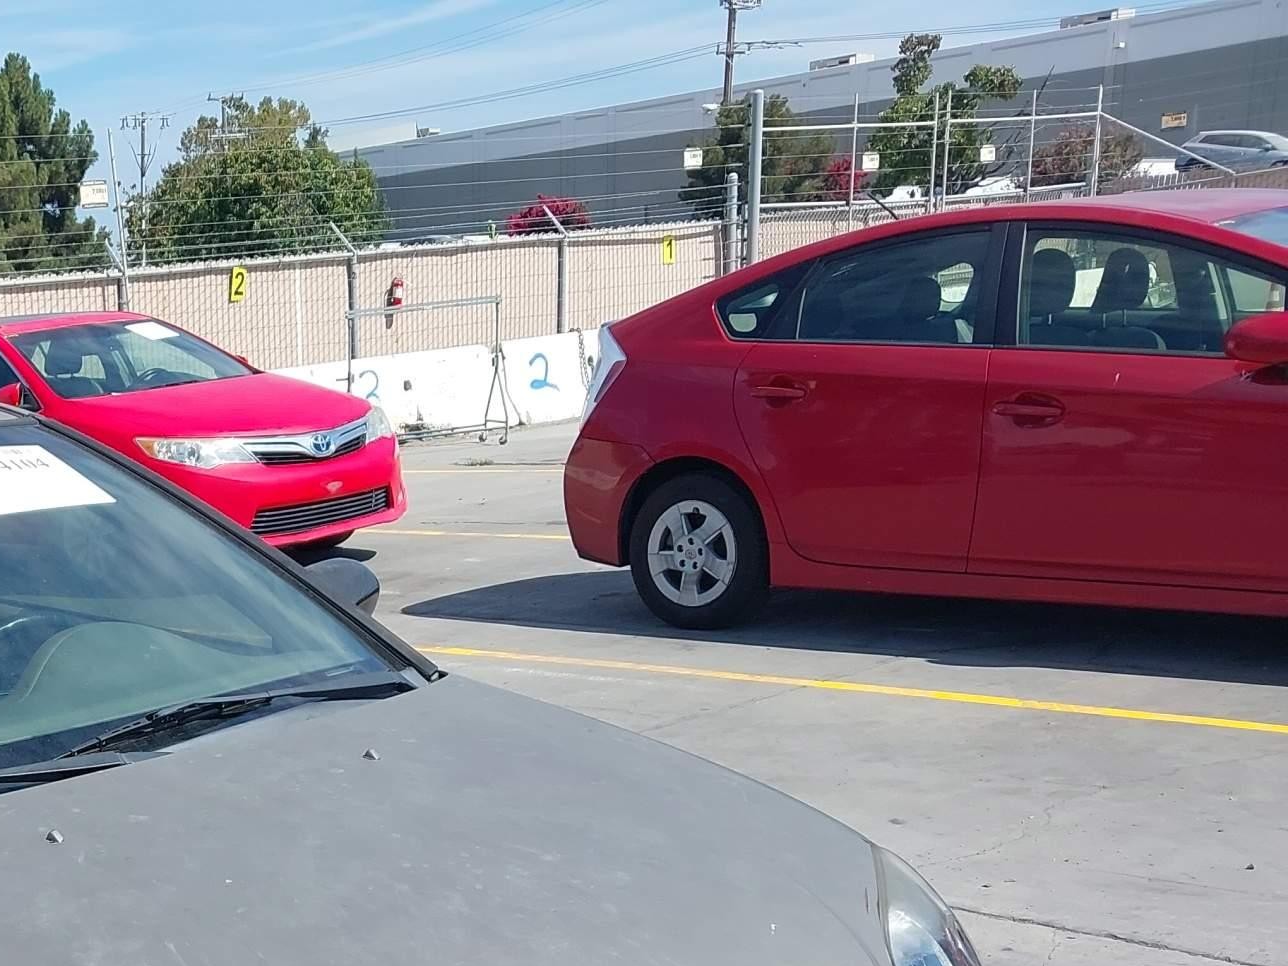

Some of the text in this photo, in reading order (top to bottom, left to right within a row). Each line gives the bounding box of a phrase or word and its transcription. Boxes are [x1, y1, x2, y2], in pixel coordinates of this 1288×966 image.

[667, 239, 672, 259] 1
[234, 272, 245, 296] 2
[359, 369, 379, 399] 2
[529, 352, 560, 392] 2
